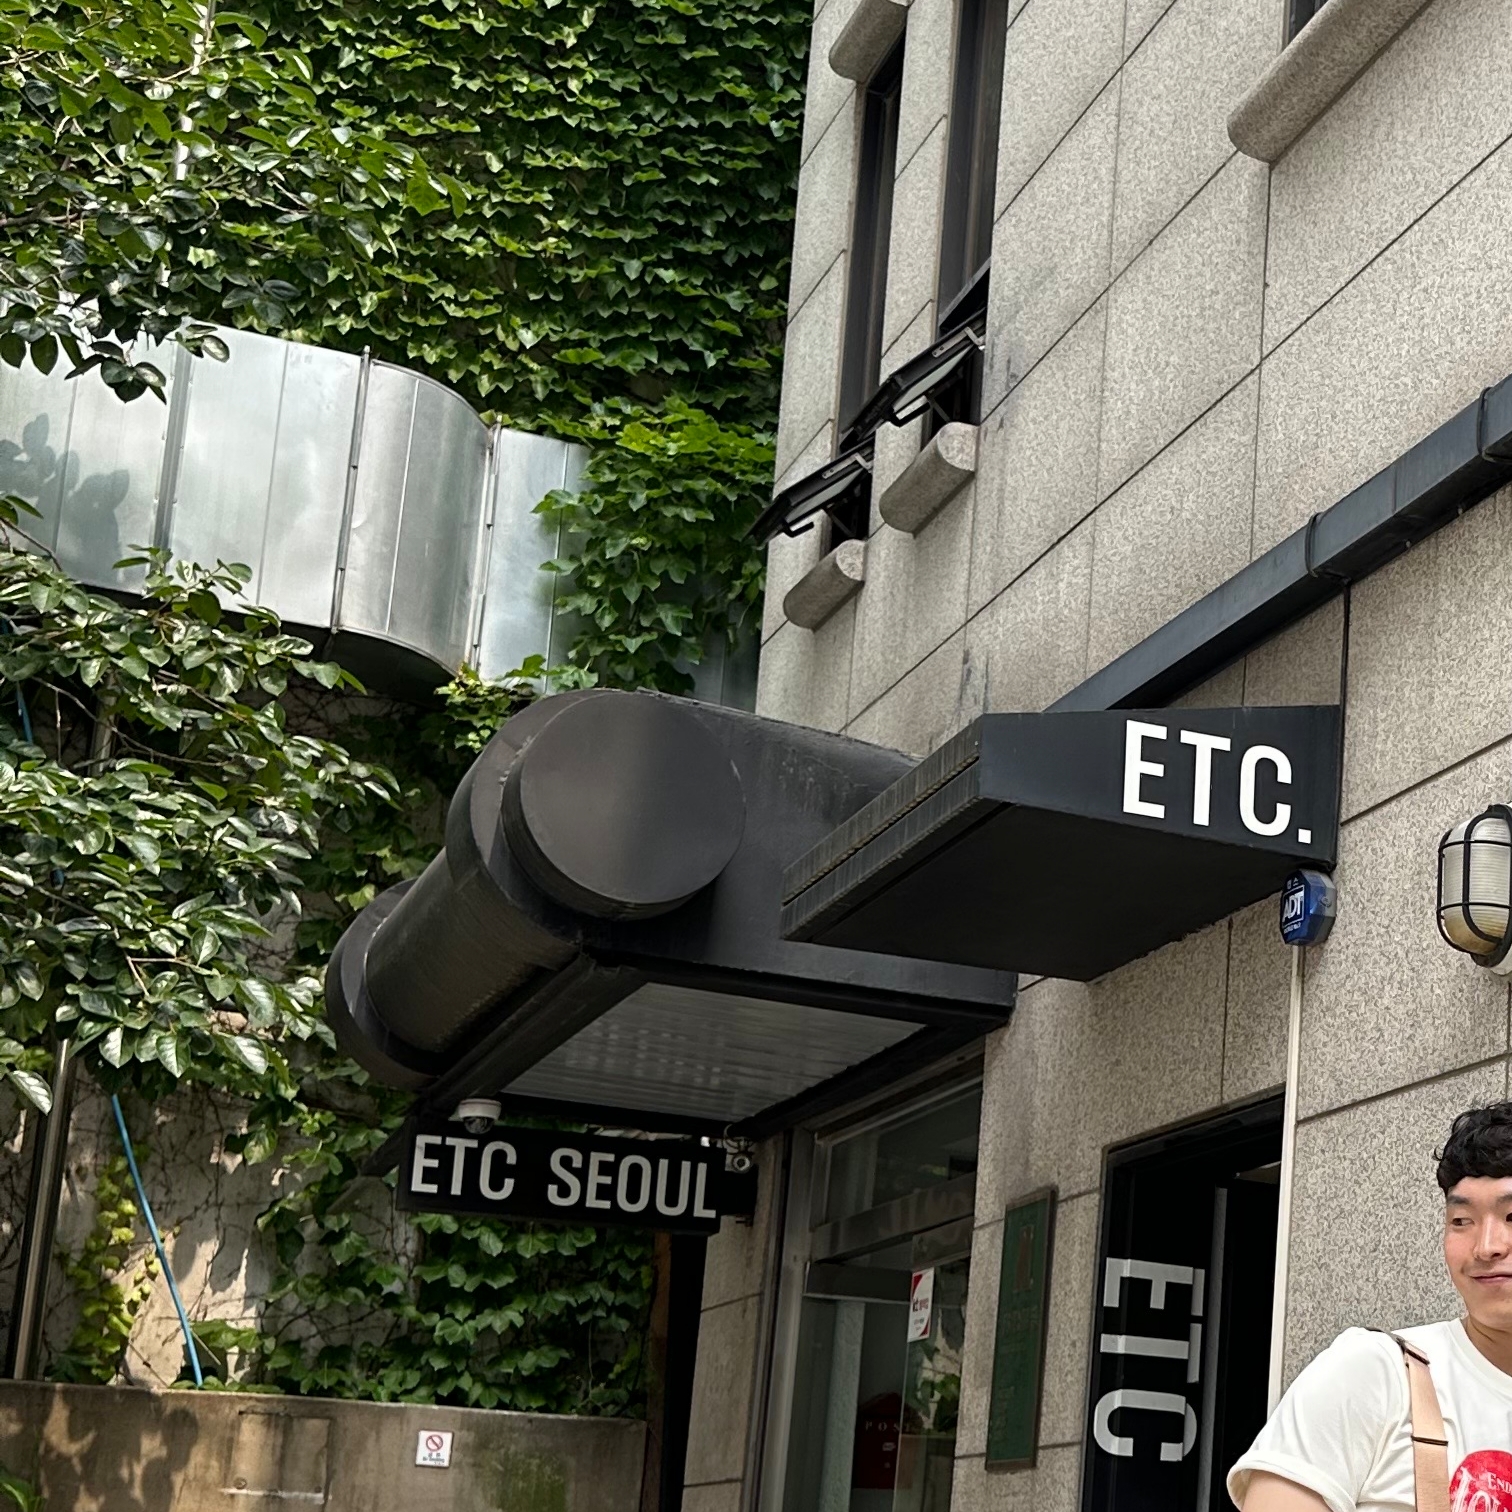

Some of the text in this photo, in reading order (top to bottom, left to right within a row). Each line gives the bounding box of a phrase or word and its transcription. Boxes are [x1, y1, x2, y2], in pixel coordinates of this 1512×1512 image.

[1122, 719, 1312, 844] ETC.
[1282, 890, 1304, 922] ADT
[411, 1134, 717, 1218] ETC SEOUL
[1093, 1256, 1205, 1461] ETC
